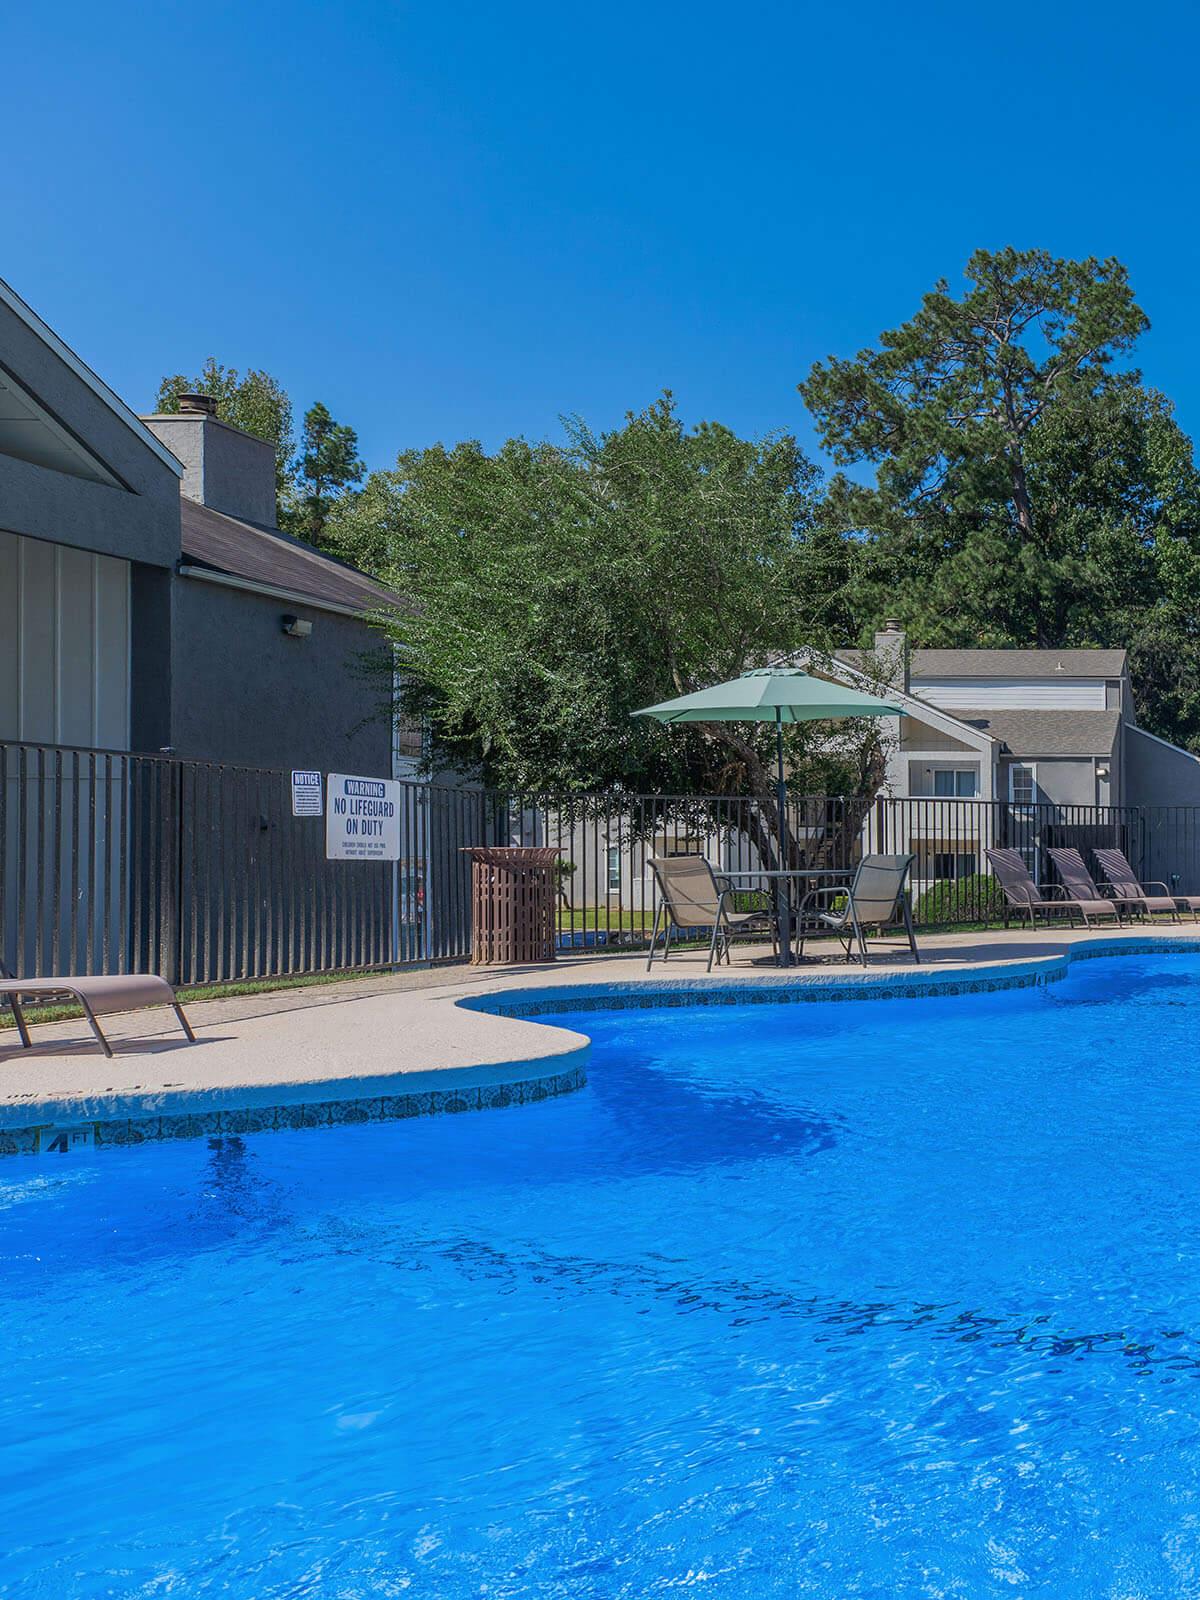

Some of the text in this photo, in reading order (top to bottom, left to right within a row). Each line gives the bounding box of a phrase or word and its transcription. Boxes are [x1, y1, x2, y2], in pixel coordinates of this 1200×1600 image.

[294, 773, 319, 784] NOTICE
[346, 781, 384, 797] WARNING
[334, 797, 346, 815] NO
[350, 798, 394, 817] LIFEGUARD
[346, 818, 383, 836] ON DUTY
[46, 1131, 88, 1153] 4 FT
